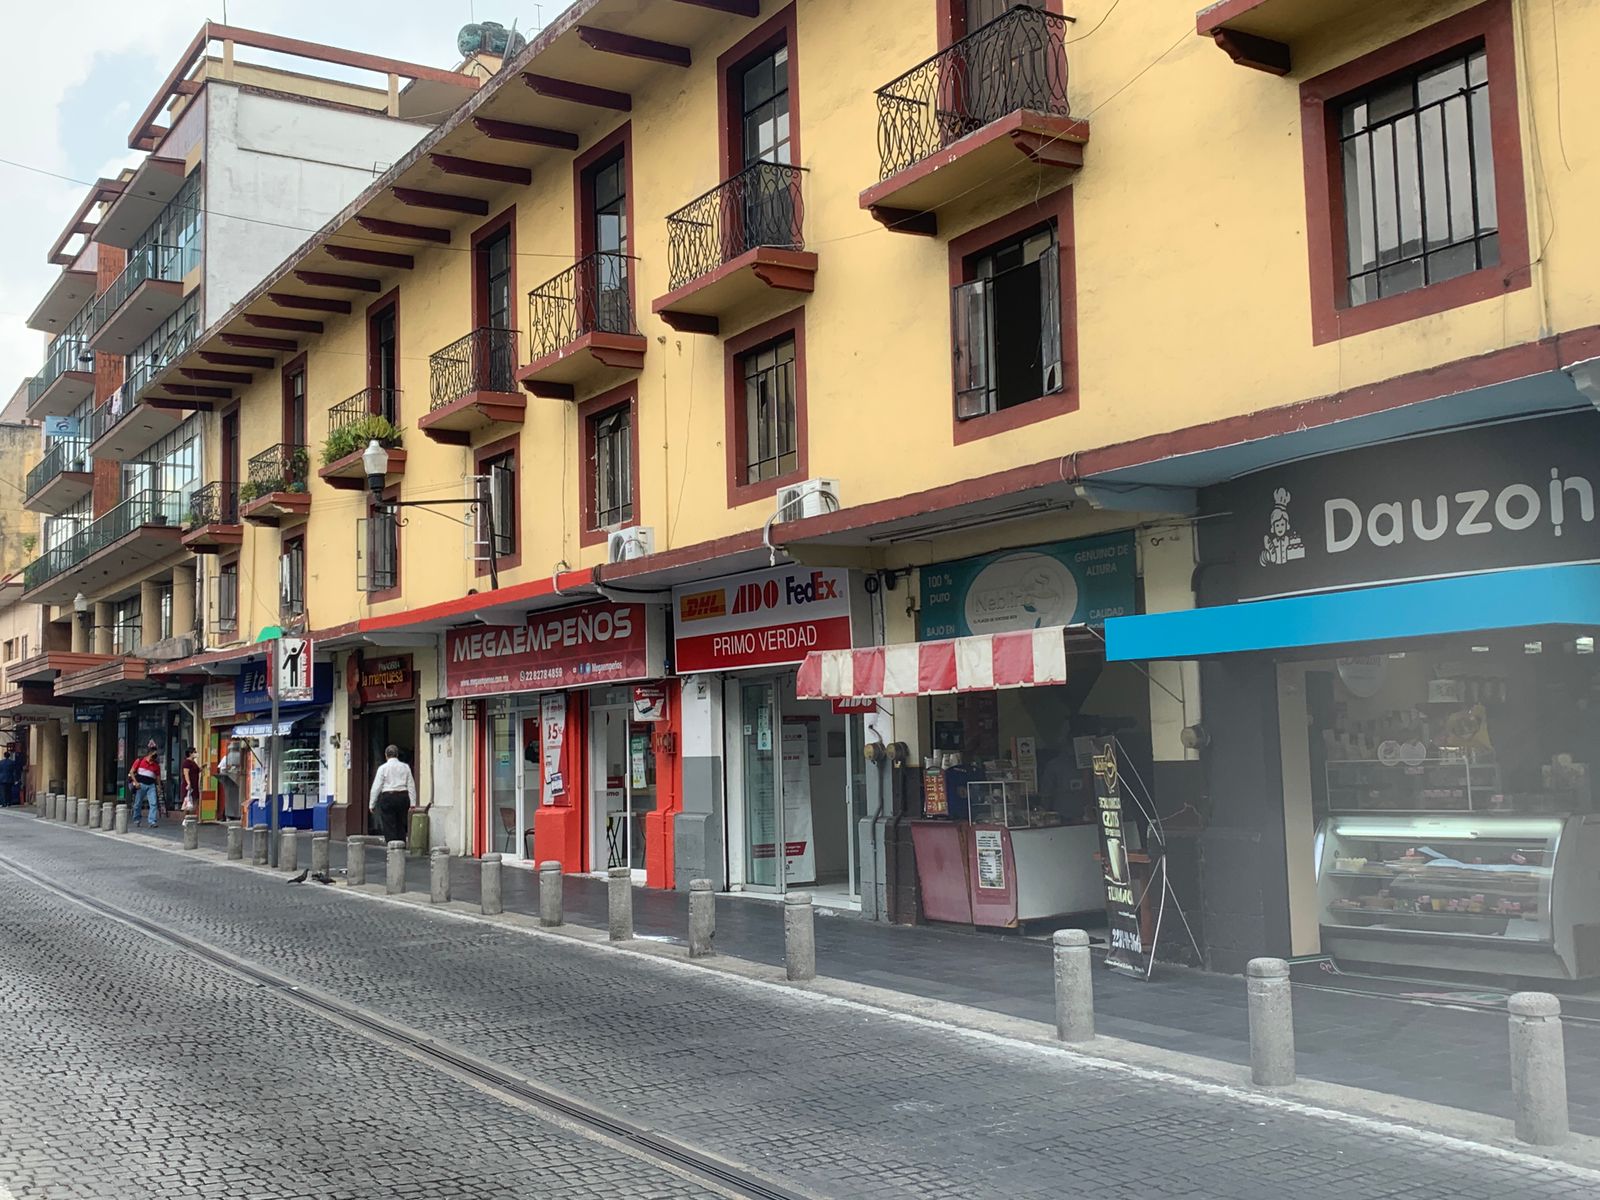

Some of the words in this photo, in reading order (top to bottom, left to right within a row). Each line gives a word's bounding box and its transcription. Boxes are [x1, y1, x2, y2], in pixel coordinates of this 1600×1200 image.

[1324, 467, 1595, 554] Dauzon
[1074, 546, 1115, 563] GENUINO
[1117, 544, 1130, 556] DE
[1086, 562, 1118, 577] ALTURA
[785, 571, 837, 605] FedEx
[928, 575, 942, 588] 100
[687, 594, 720, 617] DHL
[731, 579, 779, 615] ADO
[929, 592, 950, 606] puro
[1088, 606, 1125, 619] CALIDAD
[453, 608, 632, 663] MEGAEMPEÑOS
[713, 632, 756, 657] PRIMO
[758, 625, 817, 651] VERDAD
[925, 625, 945, 637] BAJO
